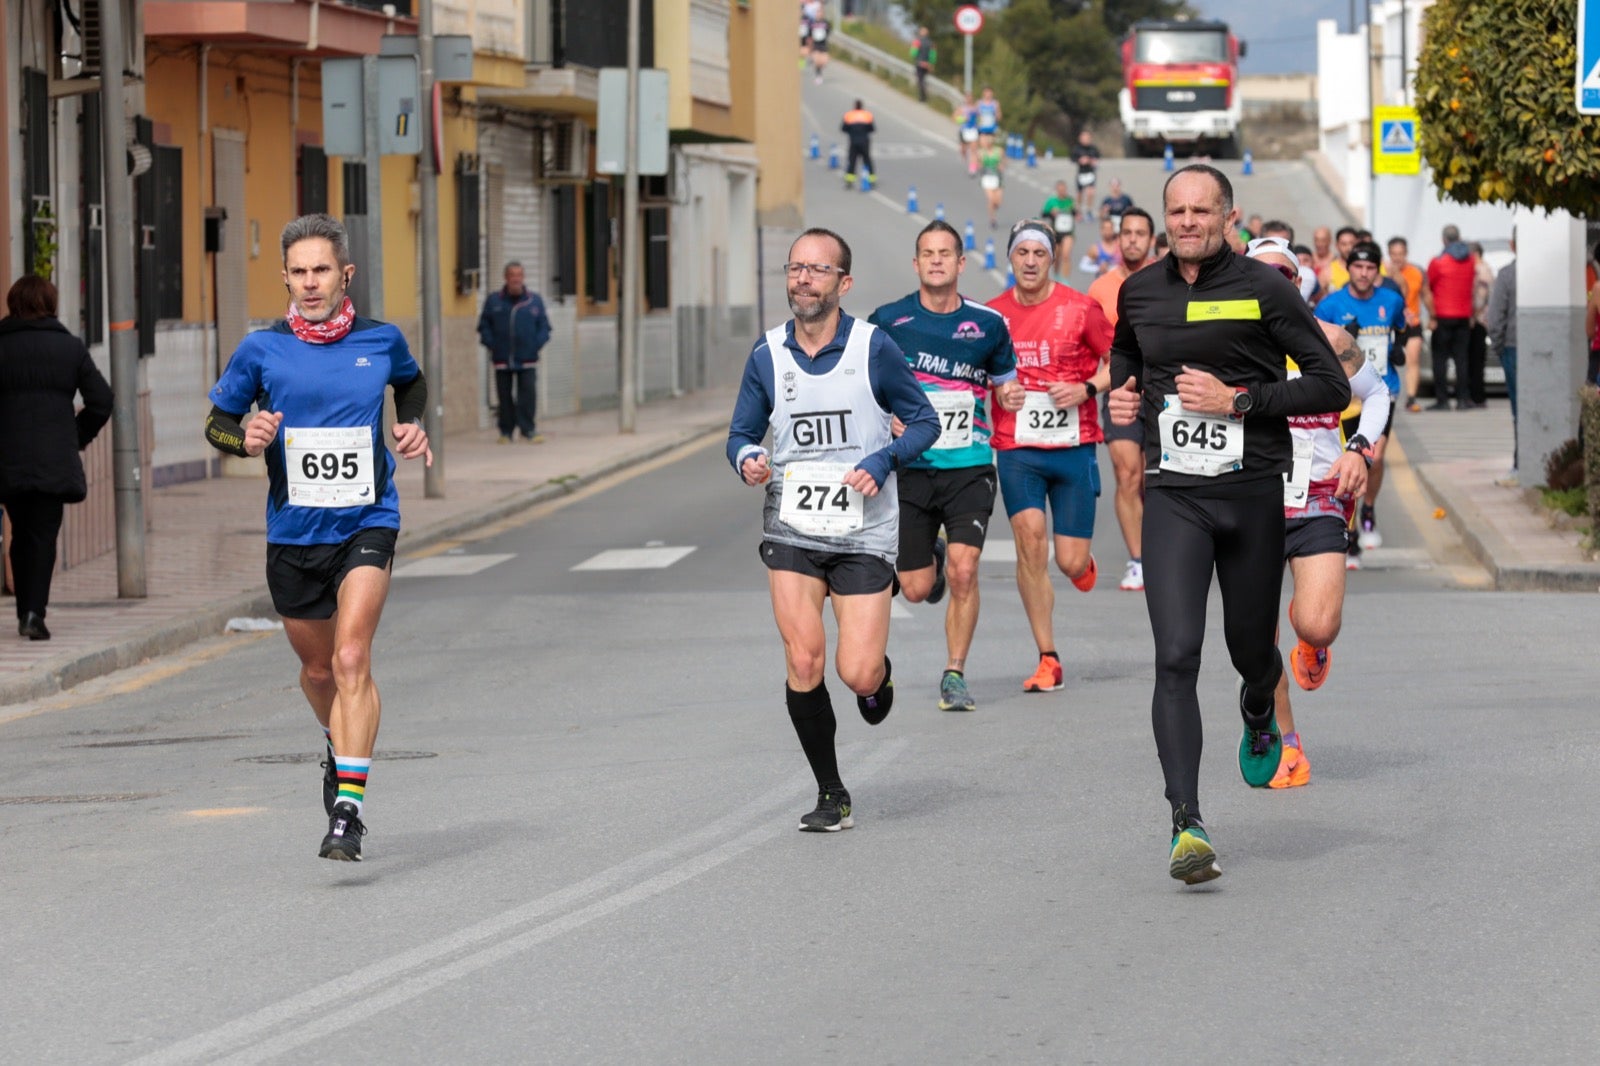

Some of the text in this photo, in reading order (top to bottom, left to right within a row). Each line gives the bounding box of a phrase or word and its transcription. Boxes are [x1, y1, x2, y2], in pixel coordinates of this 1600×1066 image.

[917, 351, 950, 374] TRAIL
[790, 409, 852, 447] GIIT
[936, 410, 969, 431] 72
[1029, 409, 1069, 429] 322
[1172, 419, 1227, 451] 645
[301, 452, 359, 480] 695
[796, 484, 850, 512] 274
